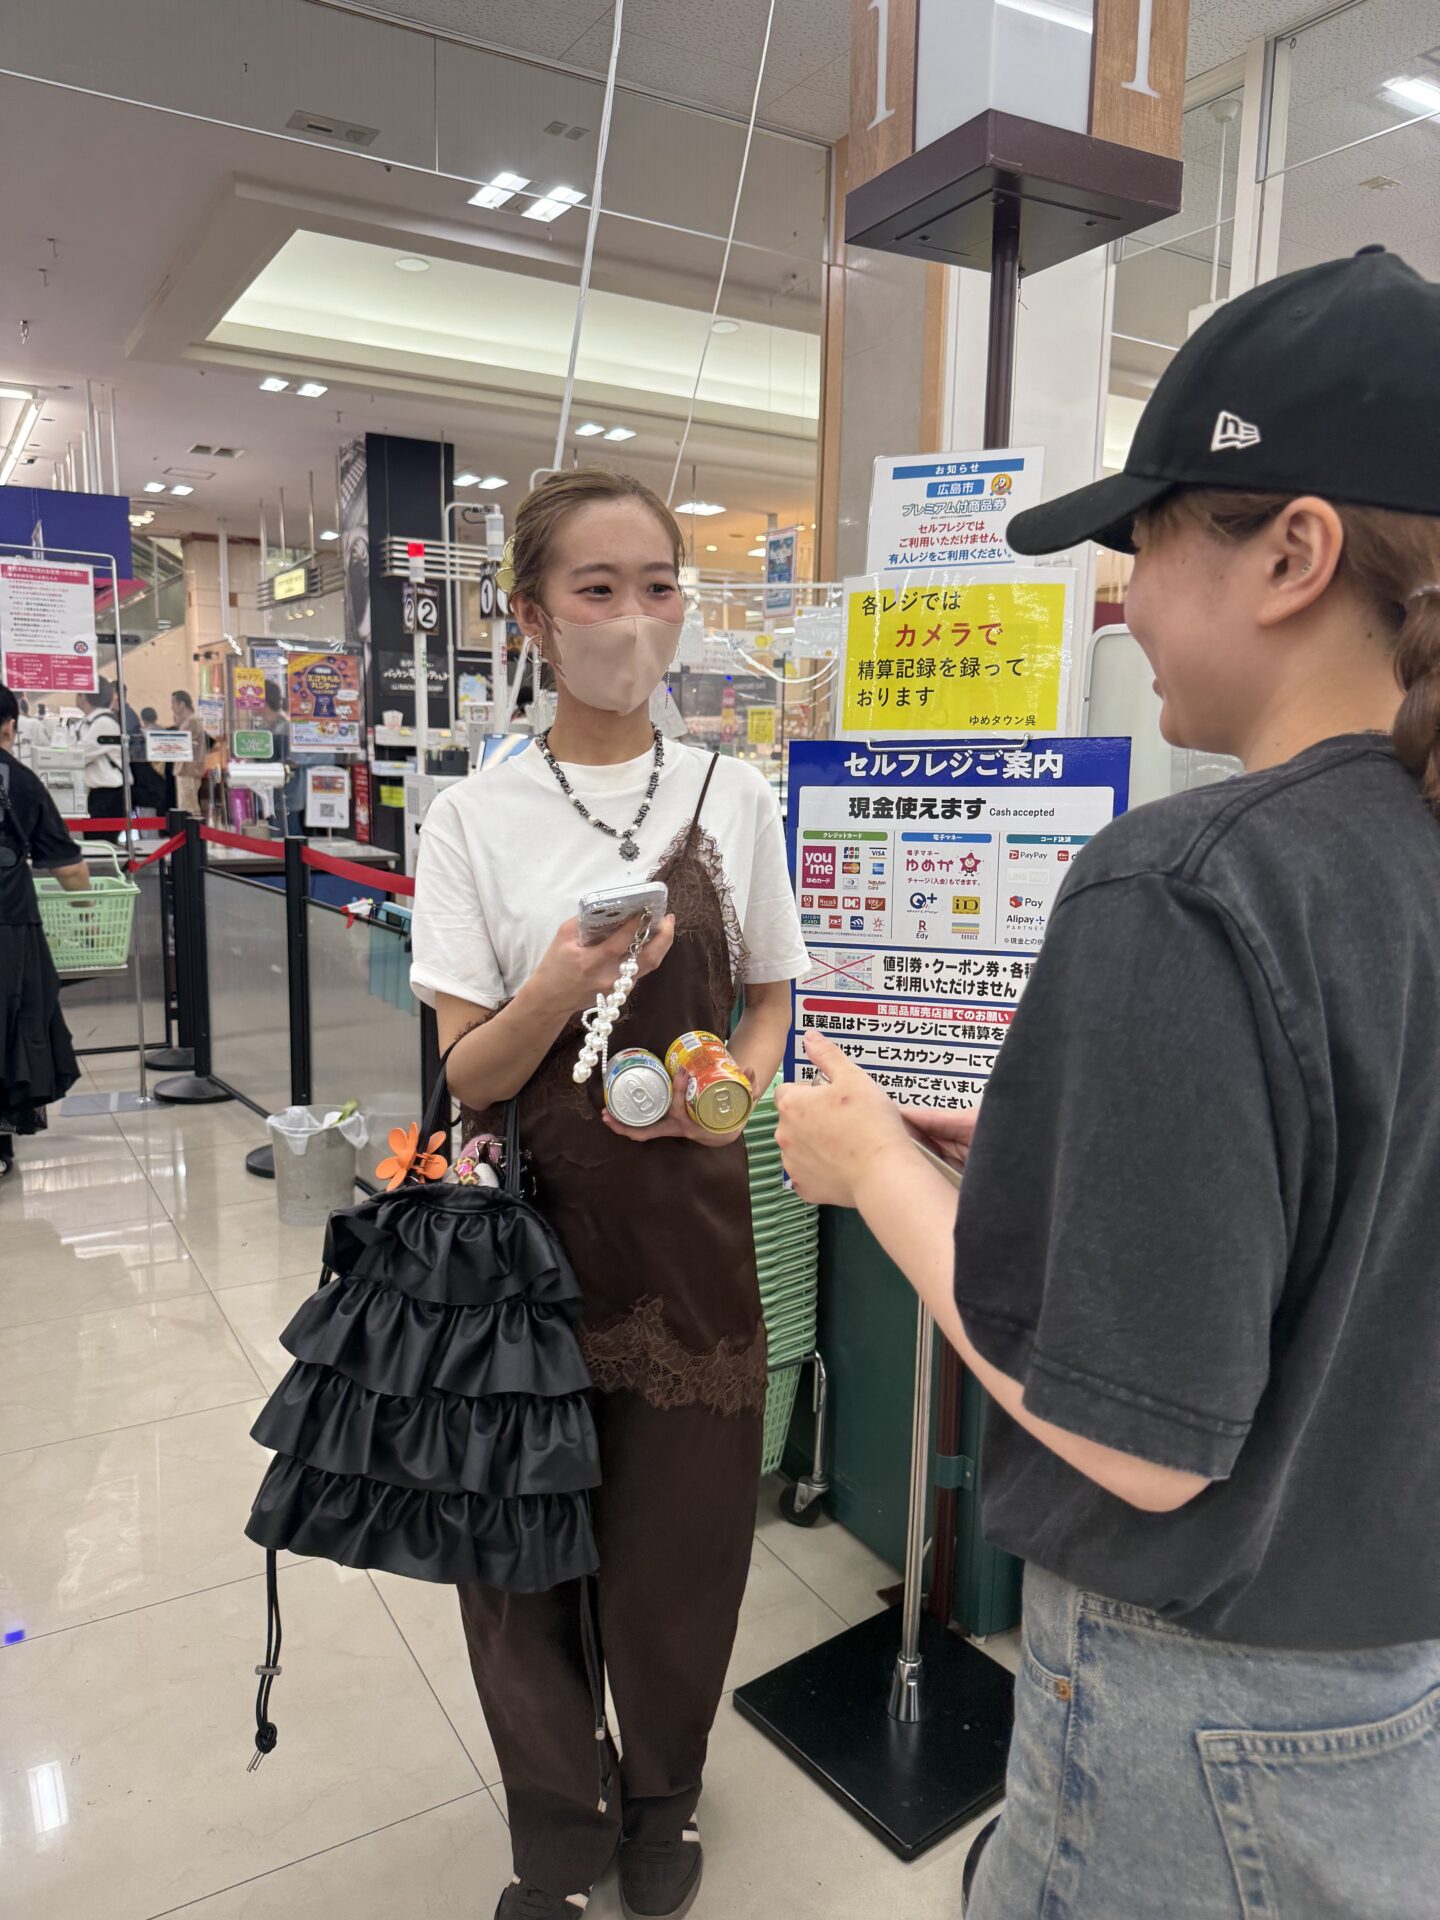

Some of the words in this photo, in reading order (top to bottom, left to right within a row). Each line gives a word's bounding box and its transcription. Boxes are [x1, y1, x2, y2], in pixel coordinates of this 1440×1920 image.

[935, 463, 980, 475] お知らせ
[937, 482, 975, 496] 広島市
[902, 498, 1006, 517] プレミアム付商品券
[918, 520, 985, 534] セルフレジでは
[899, 532, 1003, 549] ご利用いただけません。
[888, 548, 1012, 565] 有人レジをご利用ください。
[861, 591, 961, 616] 各レジでは
[422, 601, 434, 624] 2
[895, 622, 1004, 648] カメラで
[857, 656, 1025, 681] 精算記録を録って
[856, 686, 935, 708] おります
[969, 714, 1037, 726] ゆめタウン呉
[843, 749, 1064, 779] セルフレジご案内
[848, 797, 987, 820] 現金使えます
[989, 807, 1011, 817] Cash
[1012, 807, 1055, 819] accepted
[805, 852, 832, 866] you
[1020, 851, 1048, 860] PayPay
[810, 864, 833, 875] me
[844, 897, 859, 909] DC
[955, 898, 979, 910] iD
[1024, 897, 1044, 908] Pay
[916, 932, 929, 940] Edy
[883, 975, 1017, 998] ご利用いただけません
[877, 1003, 1009, 1022] 医薬品販売店舗でのお願い
[802, 1014, 1008, 1041] 医薬品はドラッグレジにて精算を
[802, 1041, 995, 1068] はサービスカウンターにて
